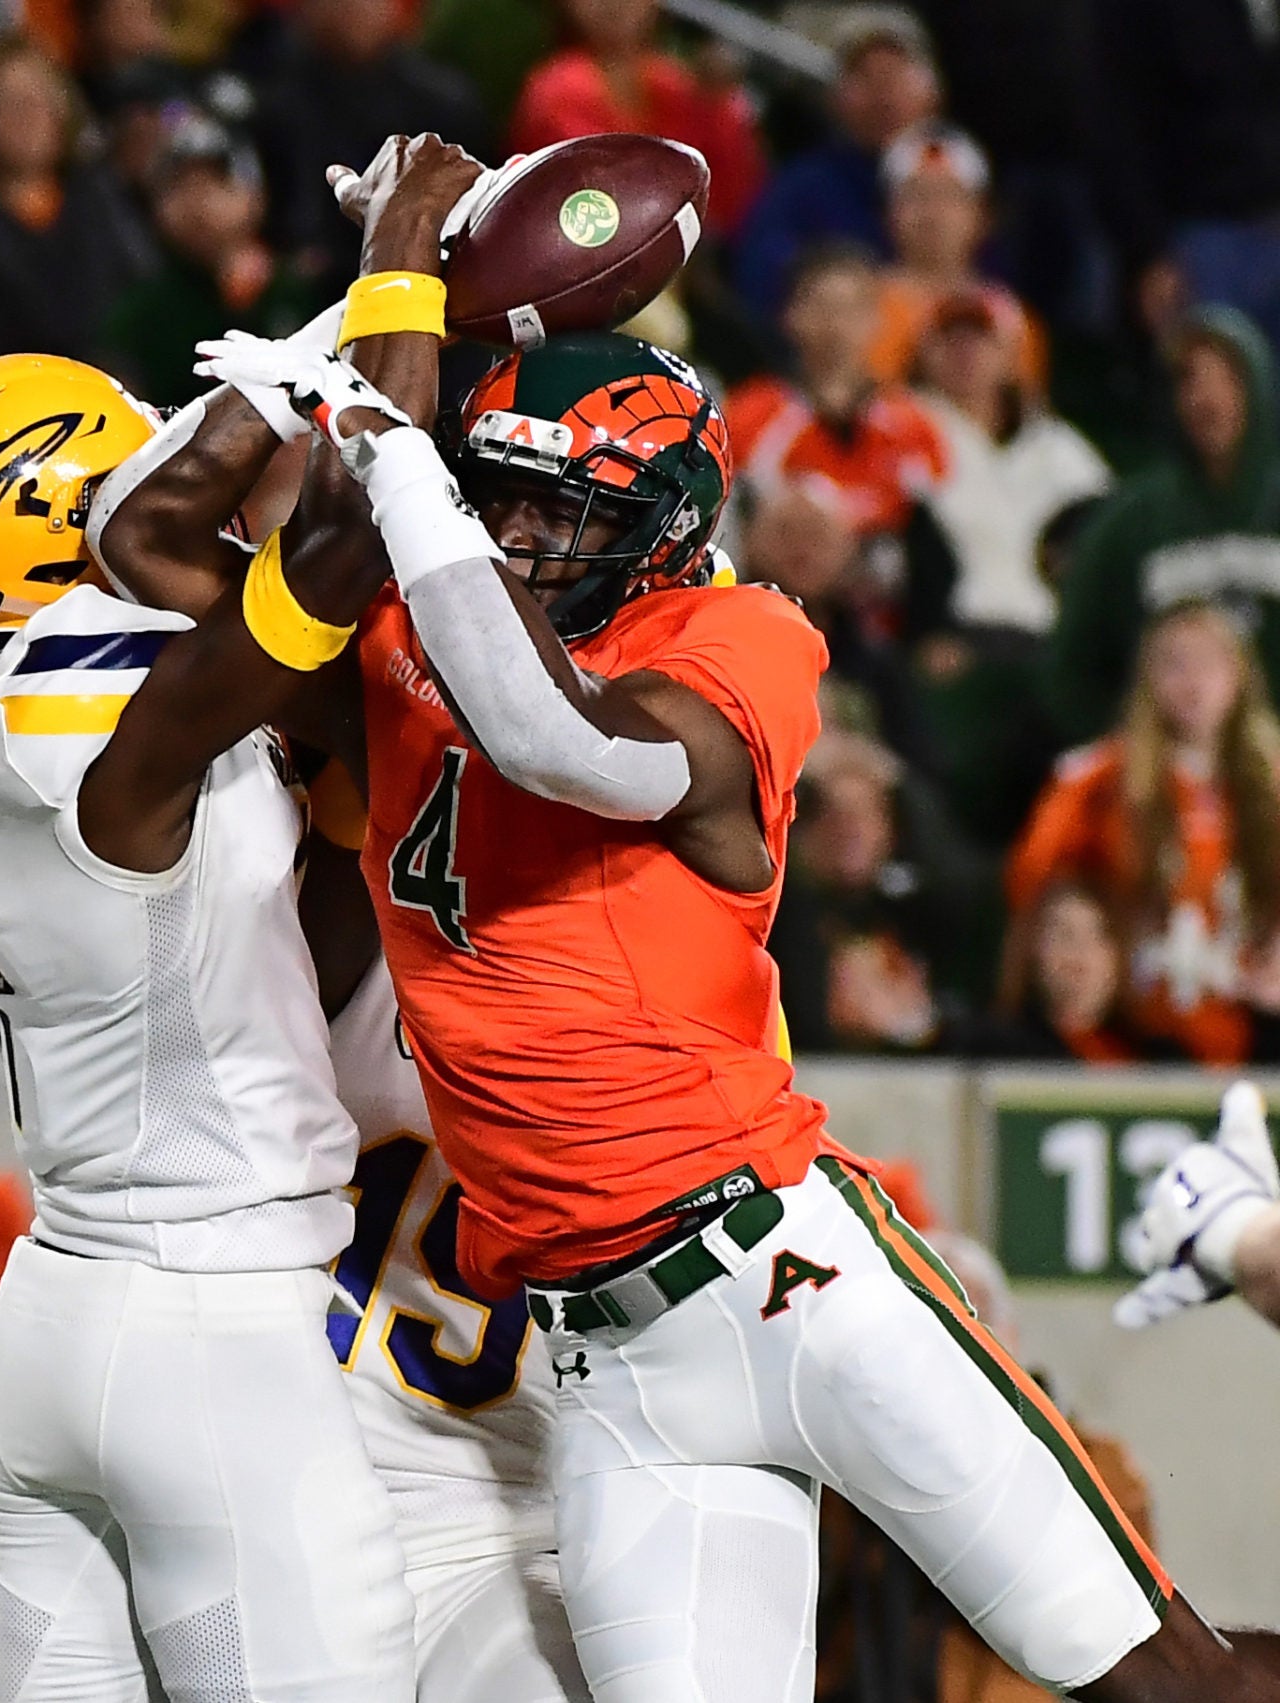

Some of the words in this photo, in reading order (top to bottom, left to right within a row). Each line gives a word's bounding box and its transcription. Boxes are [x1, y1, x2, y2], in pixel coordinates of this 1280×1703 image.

[506, 418, 535, 446] A
[387, 745, 479, 958] 4
[760, 1248, 842, 1321] A
